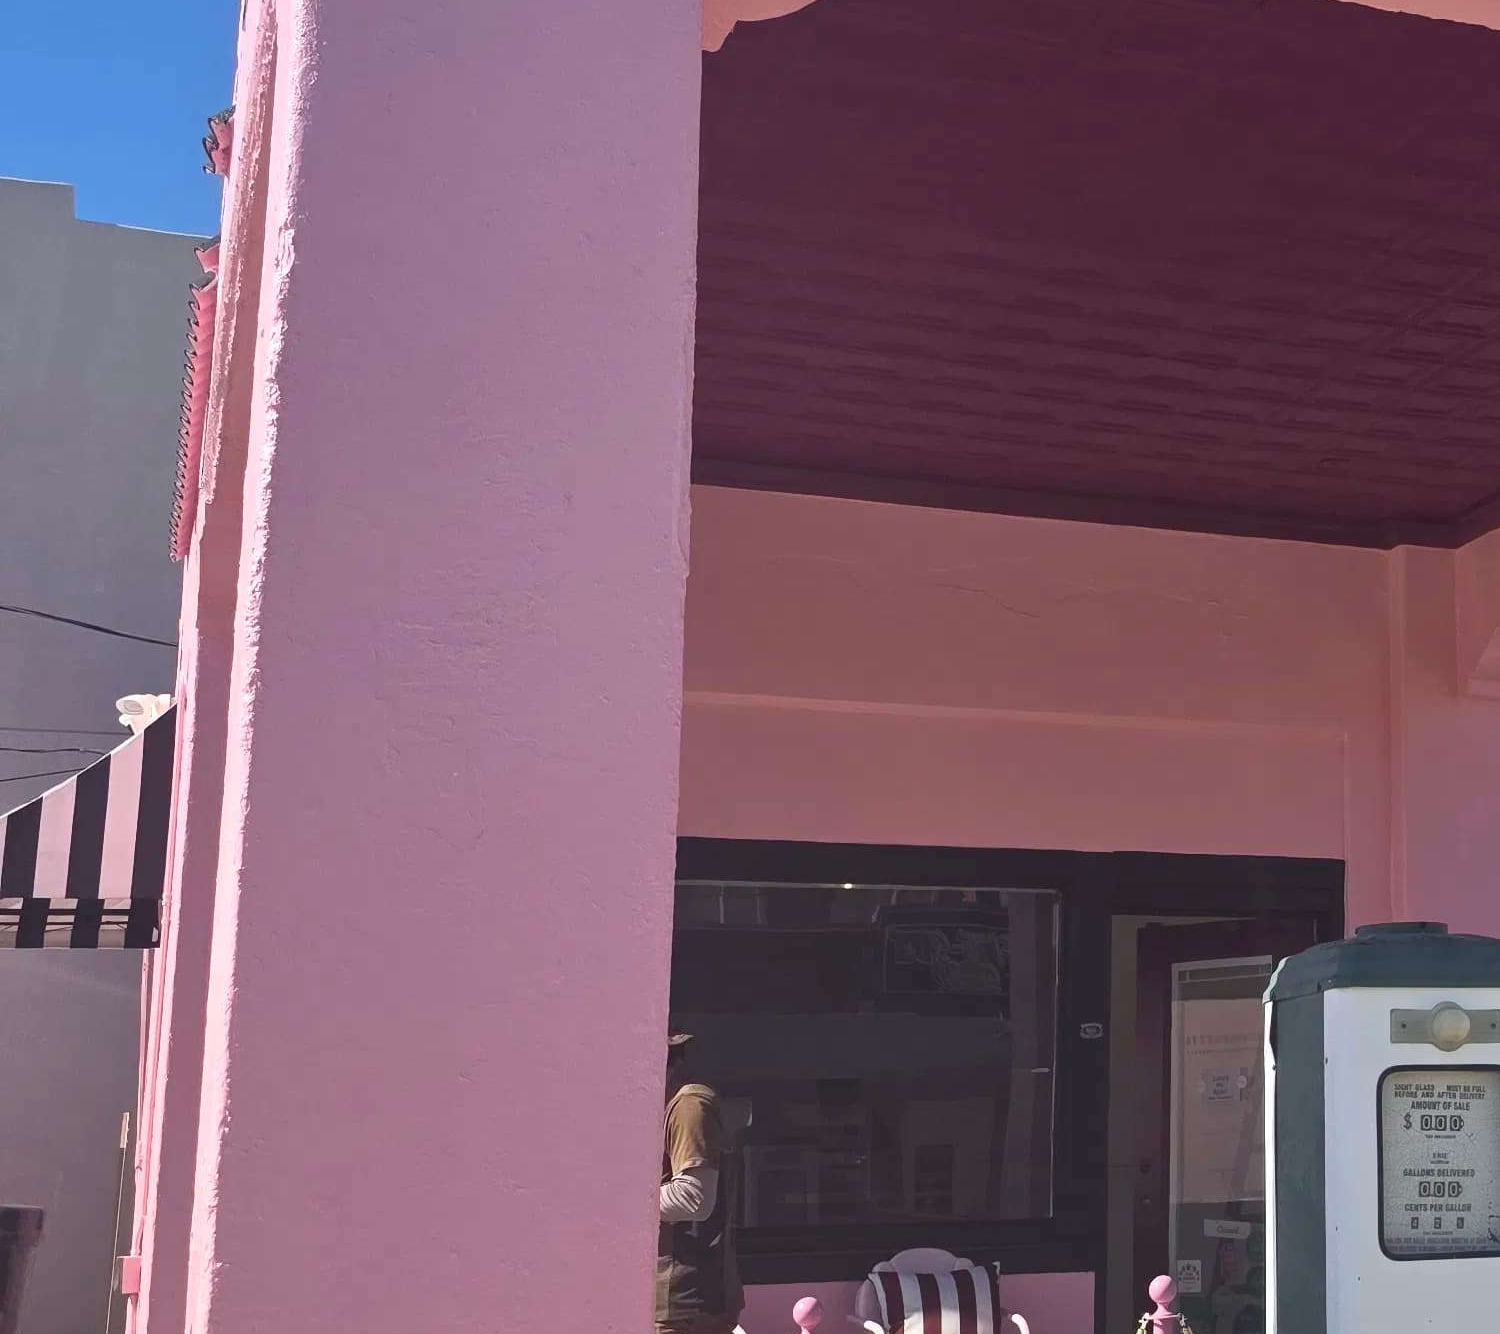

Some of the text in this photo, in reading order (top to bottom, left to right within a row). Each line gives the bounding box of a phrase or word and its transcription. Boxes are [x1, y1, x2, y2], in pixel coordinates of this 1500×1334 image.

[1421, 1091, 1434, 1099] AND
[1411, 1101, 1471, 1111] AMOUNT OF SALE
[1403, 1112, 1413, 1129] $
[1403, 1168, 1475, 1178] GALLONS DELIVERED
[1404, 1203, 1472, 1212] CENTS PER GALLON
